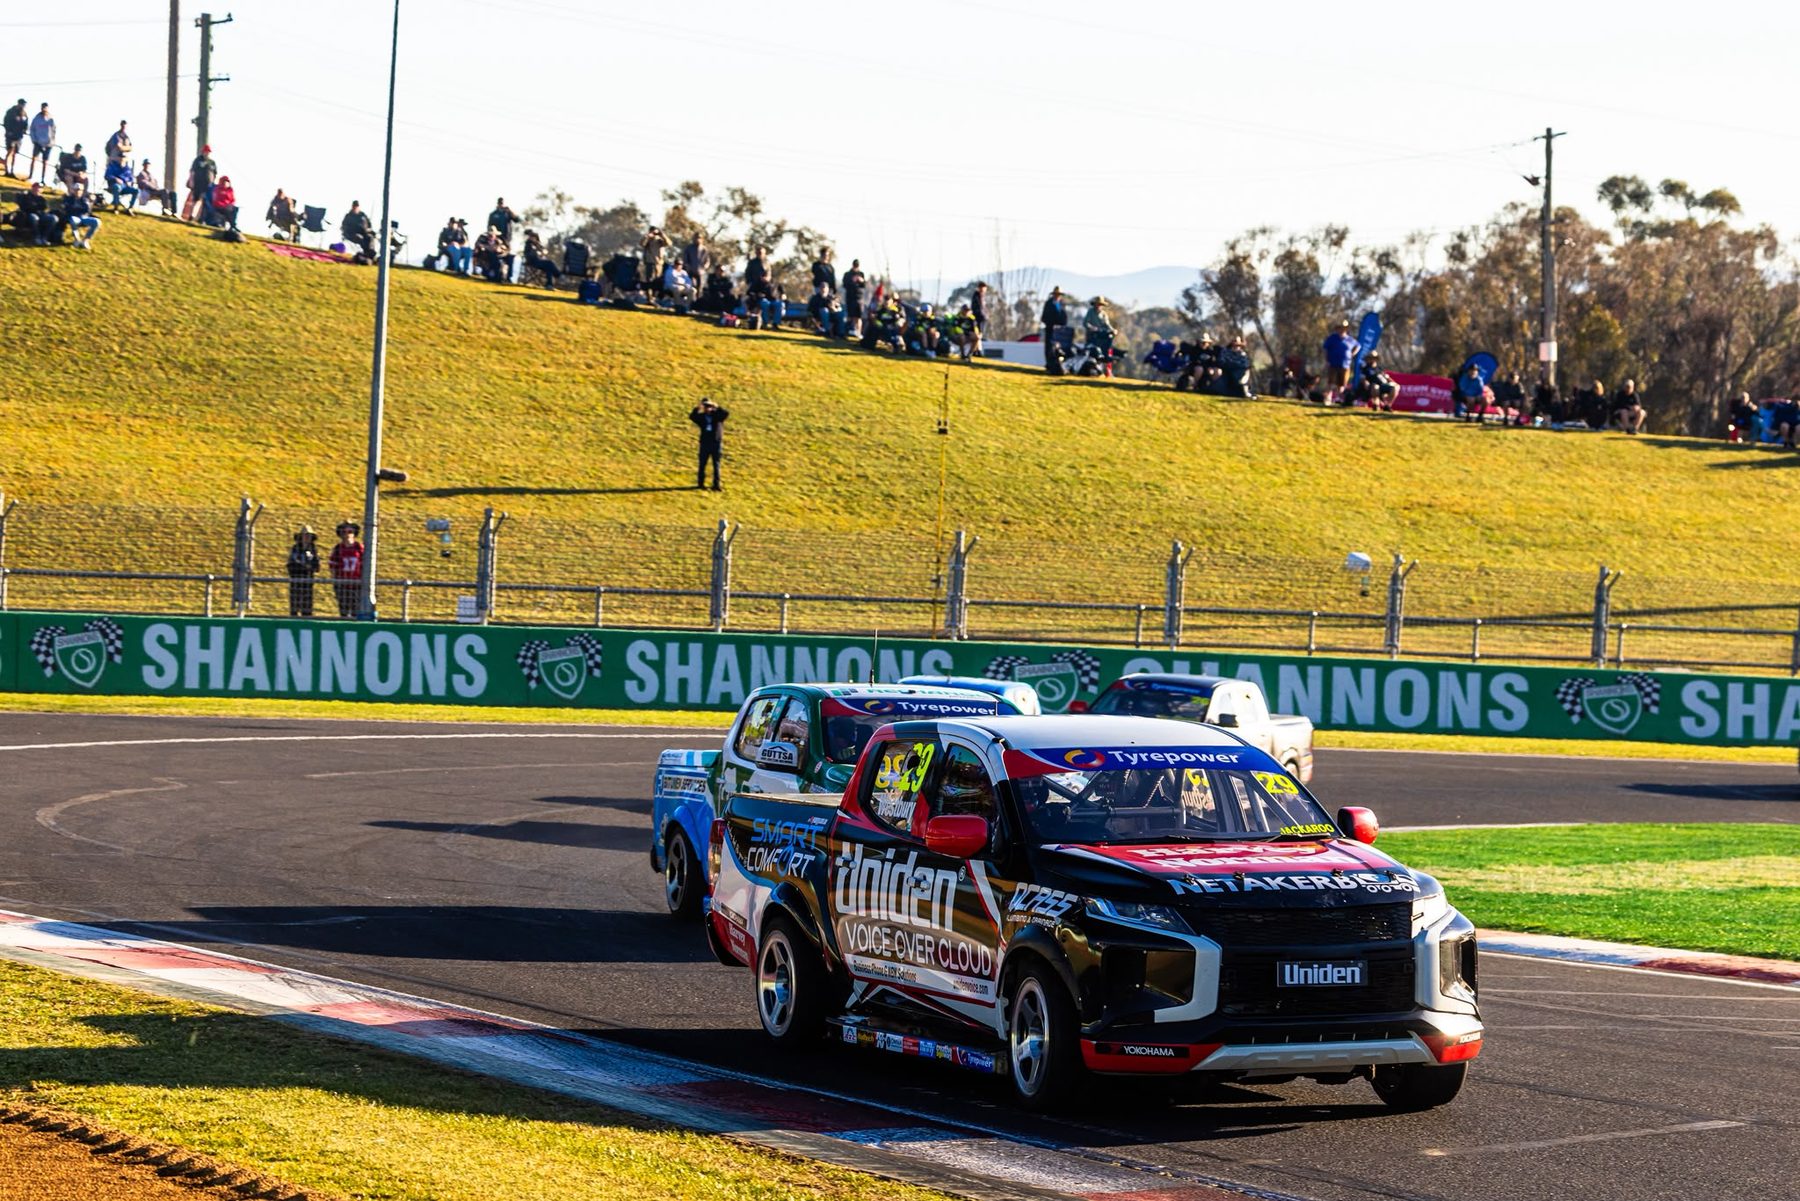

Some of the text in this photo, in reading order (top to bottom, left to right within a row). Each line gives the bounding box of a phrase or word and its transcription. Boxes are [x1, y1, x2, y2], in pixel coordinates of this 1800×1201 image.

[142, 623, 488, 698] SHANNONS
[898, 701, 996, 715] Tyrepower
[1108, 750, 1239, 765] Tyrepower
[1257, 772, 1299, 795] 29
[751, 817, 824, 850] SMART
[747, 845, 815, 878] COMFORT
[1151, 856, 1363, 868] Norman
[835, 842, 958, 932] Uniden
[845, 921, 992, 976] VOICE OVER CLOUD
[1284, 963, 1361, 984] Uniden
[1123, 1046, 1175, 1057] YOKOHAMA
